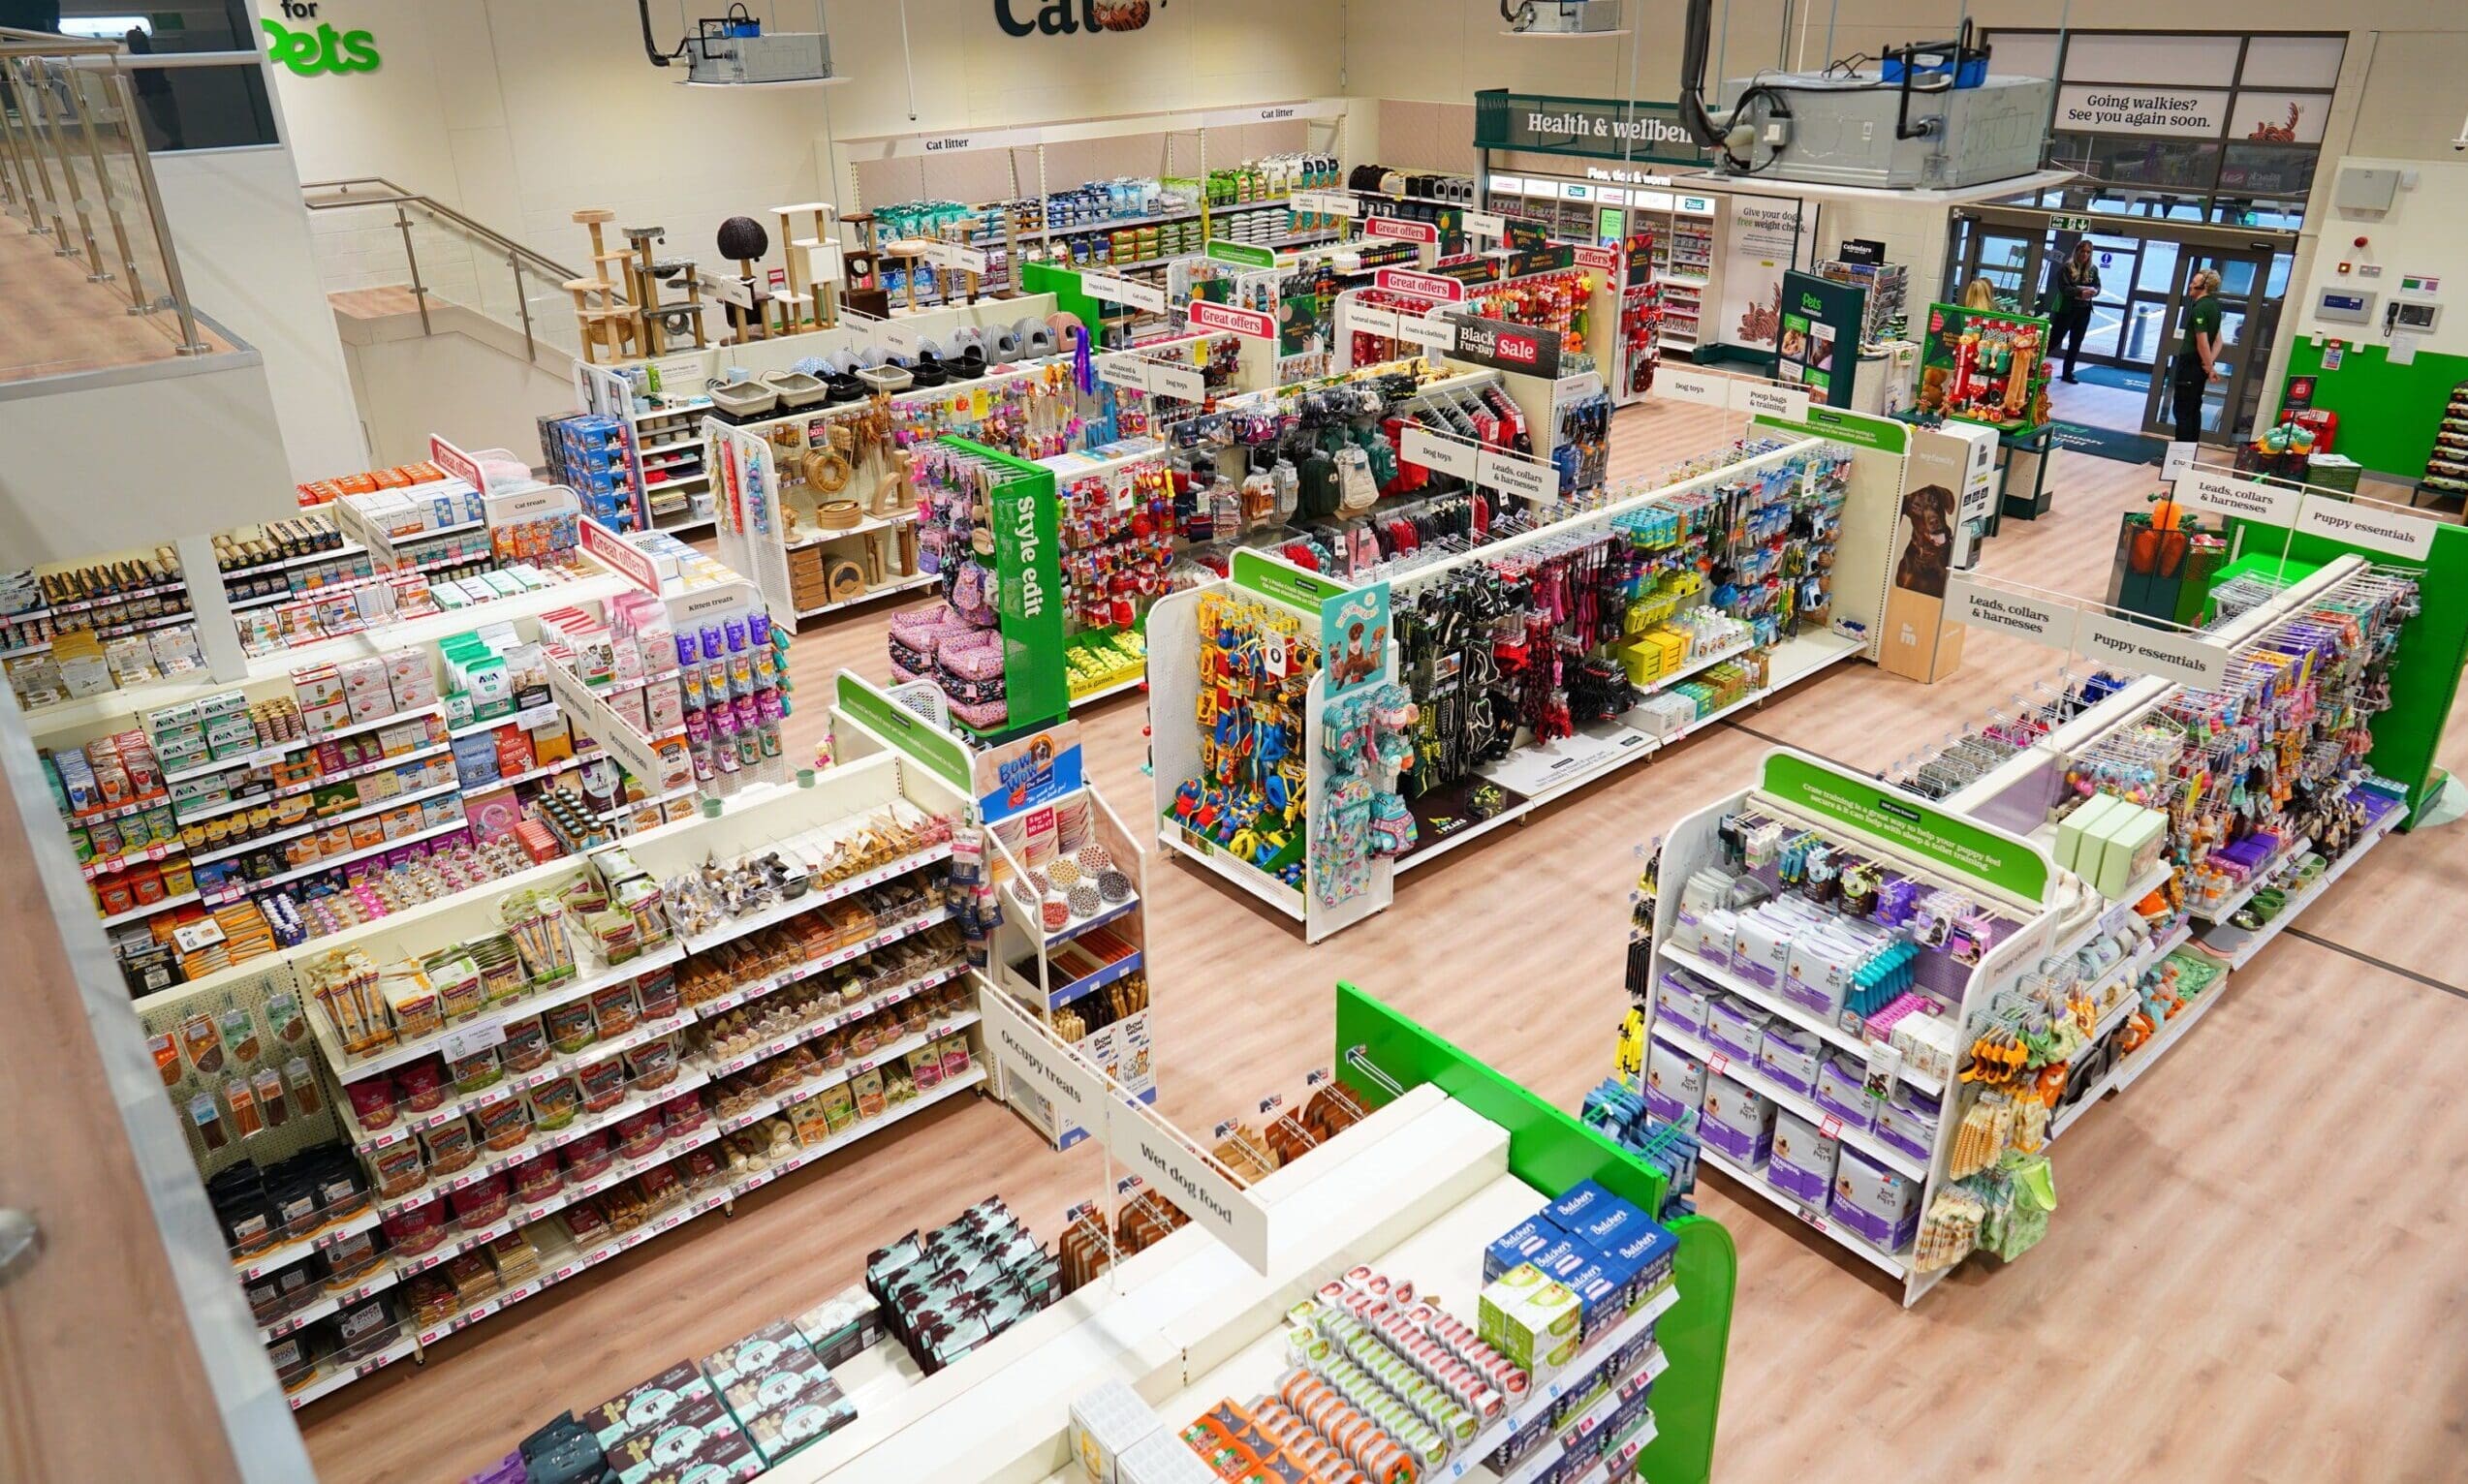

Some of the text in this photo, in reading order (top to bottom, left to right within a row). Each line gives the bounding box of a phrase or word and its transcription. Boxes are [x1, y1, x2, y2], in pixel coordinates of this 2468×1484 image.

[280, 0, 318, 17] for
[2087, 95, 2198, 111] Going walkies?
[1262, 108, 1295, 119] Cat litter
[2068, 108, 2211, 128] See you again soon.
[1528, 112, 1711, 150] Health & wellbei
[926, 138, 969, 150] Cat litter
[1612, 169, 1633, 183] tick
[1633, 170, 1642, 183] &
[1642, 174, 1671, 186] worm
[1743, 206, 1761, 217] Give
[1762, 210, 1780, 220] your
[1377, 224, 1424, 238] Great offers
[1737, 217, 1808, 233] free weight chek.
[1578, 251, 1609, 264] offers
[1390, 276, 1448, 294] Great offers
[1802, 293, 1822, 310] Pets
[1203, 309, 1261, 331] Great offers
[1351, 315, 1391, 328] Natural nutrition
[1405, 325, 1420, 334] Coats
[1424, 329, 1448, 341] clothing
[1460, 326, 1534, 359] Black Sale
[1460, 341, 1495, 358] Fur-Day
[1166, 379, 1188, 390] Dog toys
[1675, 382, 1704, 393] Dog toys
[1750, 391, 1787, 404] Poop bags
[1756, 402, 1787, 414] training
[1422, 447, 1452, 462] Dog toys
[1492, 462, 1543, 483] Leads, collars
[1500, 474, 1539, 492] harnesses
[2199, 481, 2273, 505] Leads, collars
[526, 499, 547, 508] treats
[2210, 492, 2266, 513] harnesses
[2313, 511, 2416, 542] Puppy essentials
[592, 534, 647, 579] Great offers
[1015, 496, 1044, 619] Style edit
[688, 596, 734, 612] Kitten treats
[1969, 594, 2049, 623] Leads, collars
[1972, 607, 2043, 633] & harnesses
[2093, 632, 2206, 672] Puppy essentials
[479, 672, 499, 684] AVA
[1074, 684, 1087, 694] Fun
[205, 704, 225, 714] AVA
[155, 717, 175, 728] AVA
[213, 731, 233, 742] AVA
[163, 745, 183, 756] AVA
[174, 786, 198, 796] AVA
[1802, 783, 1823, 795] Crate
[1823, 790, 1855, 809] training
[1907, 823, 1917, 833] to
[1917, 827, 1935, 841] help
[1936, 836, 1955, 849] your
[1956, 845, 1985, 861] puppy
[1850, 810, 1865, 820] can
[1864, 815, 1883, 828] help
[1883, 823, 1902, 835] with
[1001, 1030, 1081, 1103] Occupy treats
[1140, 1141, 1233, 1224] Wet dog food
